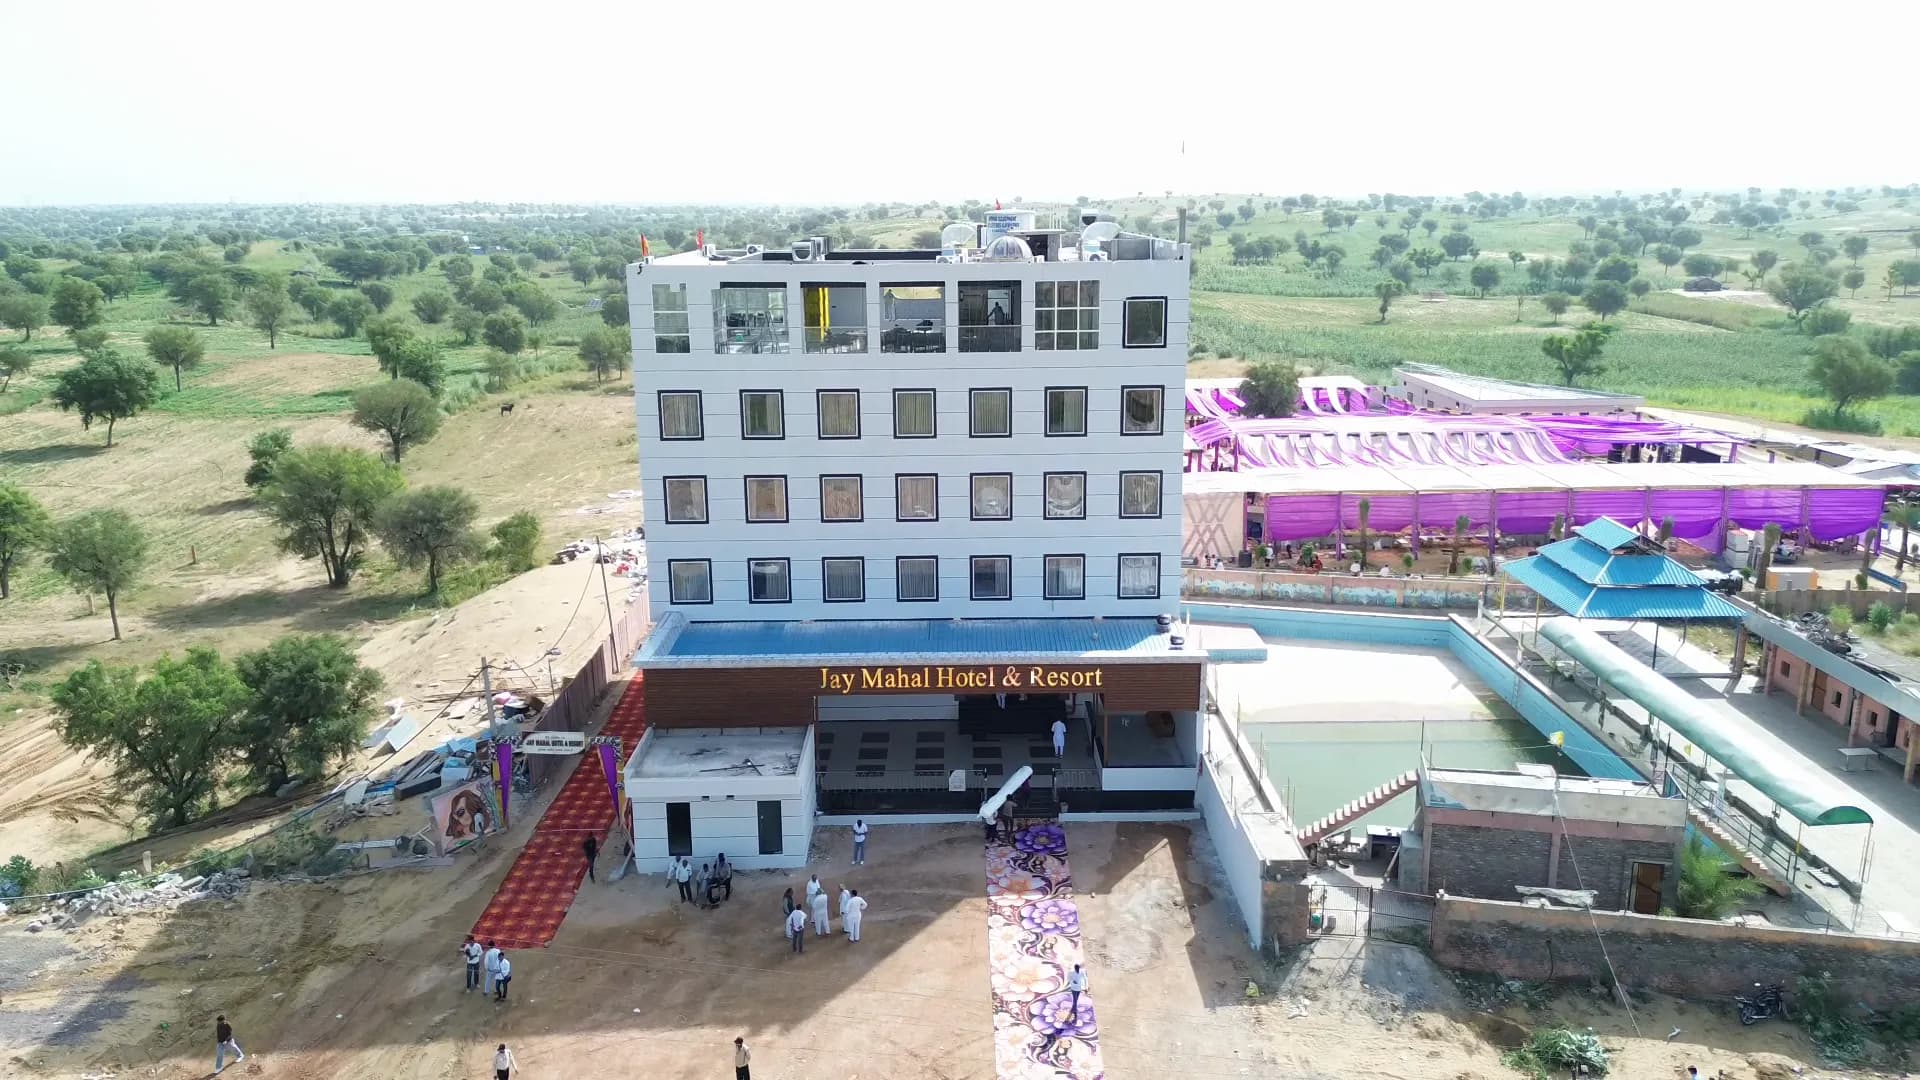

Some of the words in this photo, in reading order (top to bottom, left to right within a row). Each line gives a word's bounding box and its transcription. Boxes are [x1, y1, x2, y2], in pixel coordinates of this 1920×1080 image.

[820, 667, 856, 694] Jay
[861, 667, 930, 688] Mahal
[936, 667, 995, 688] Hotel
[1002, 665, 1022, 687] &
[1030, 666, 1102, 687] Resort
